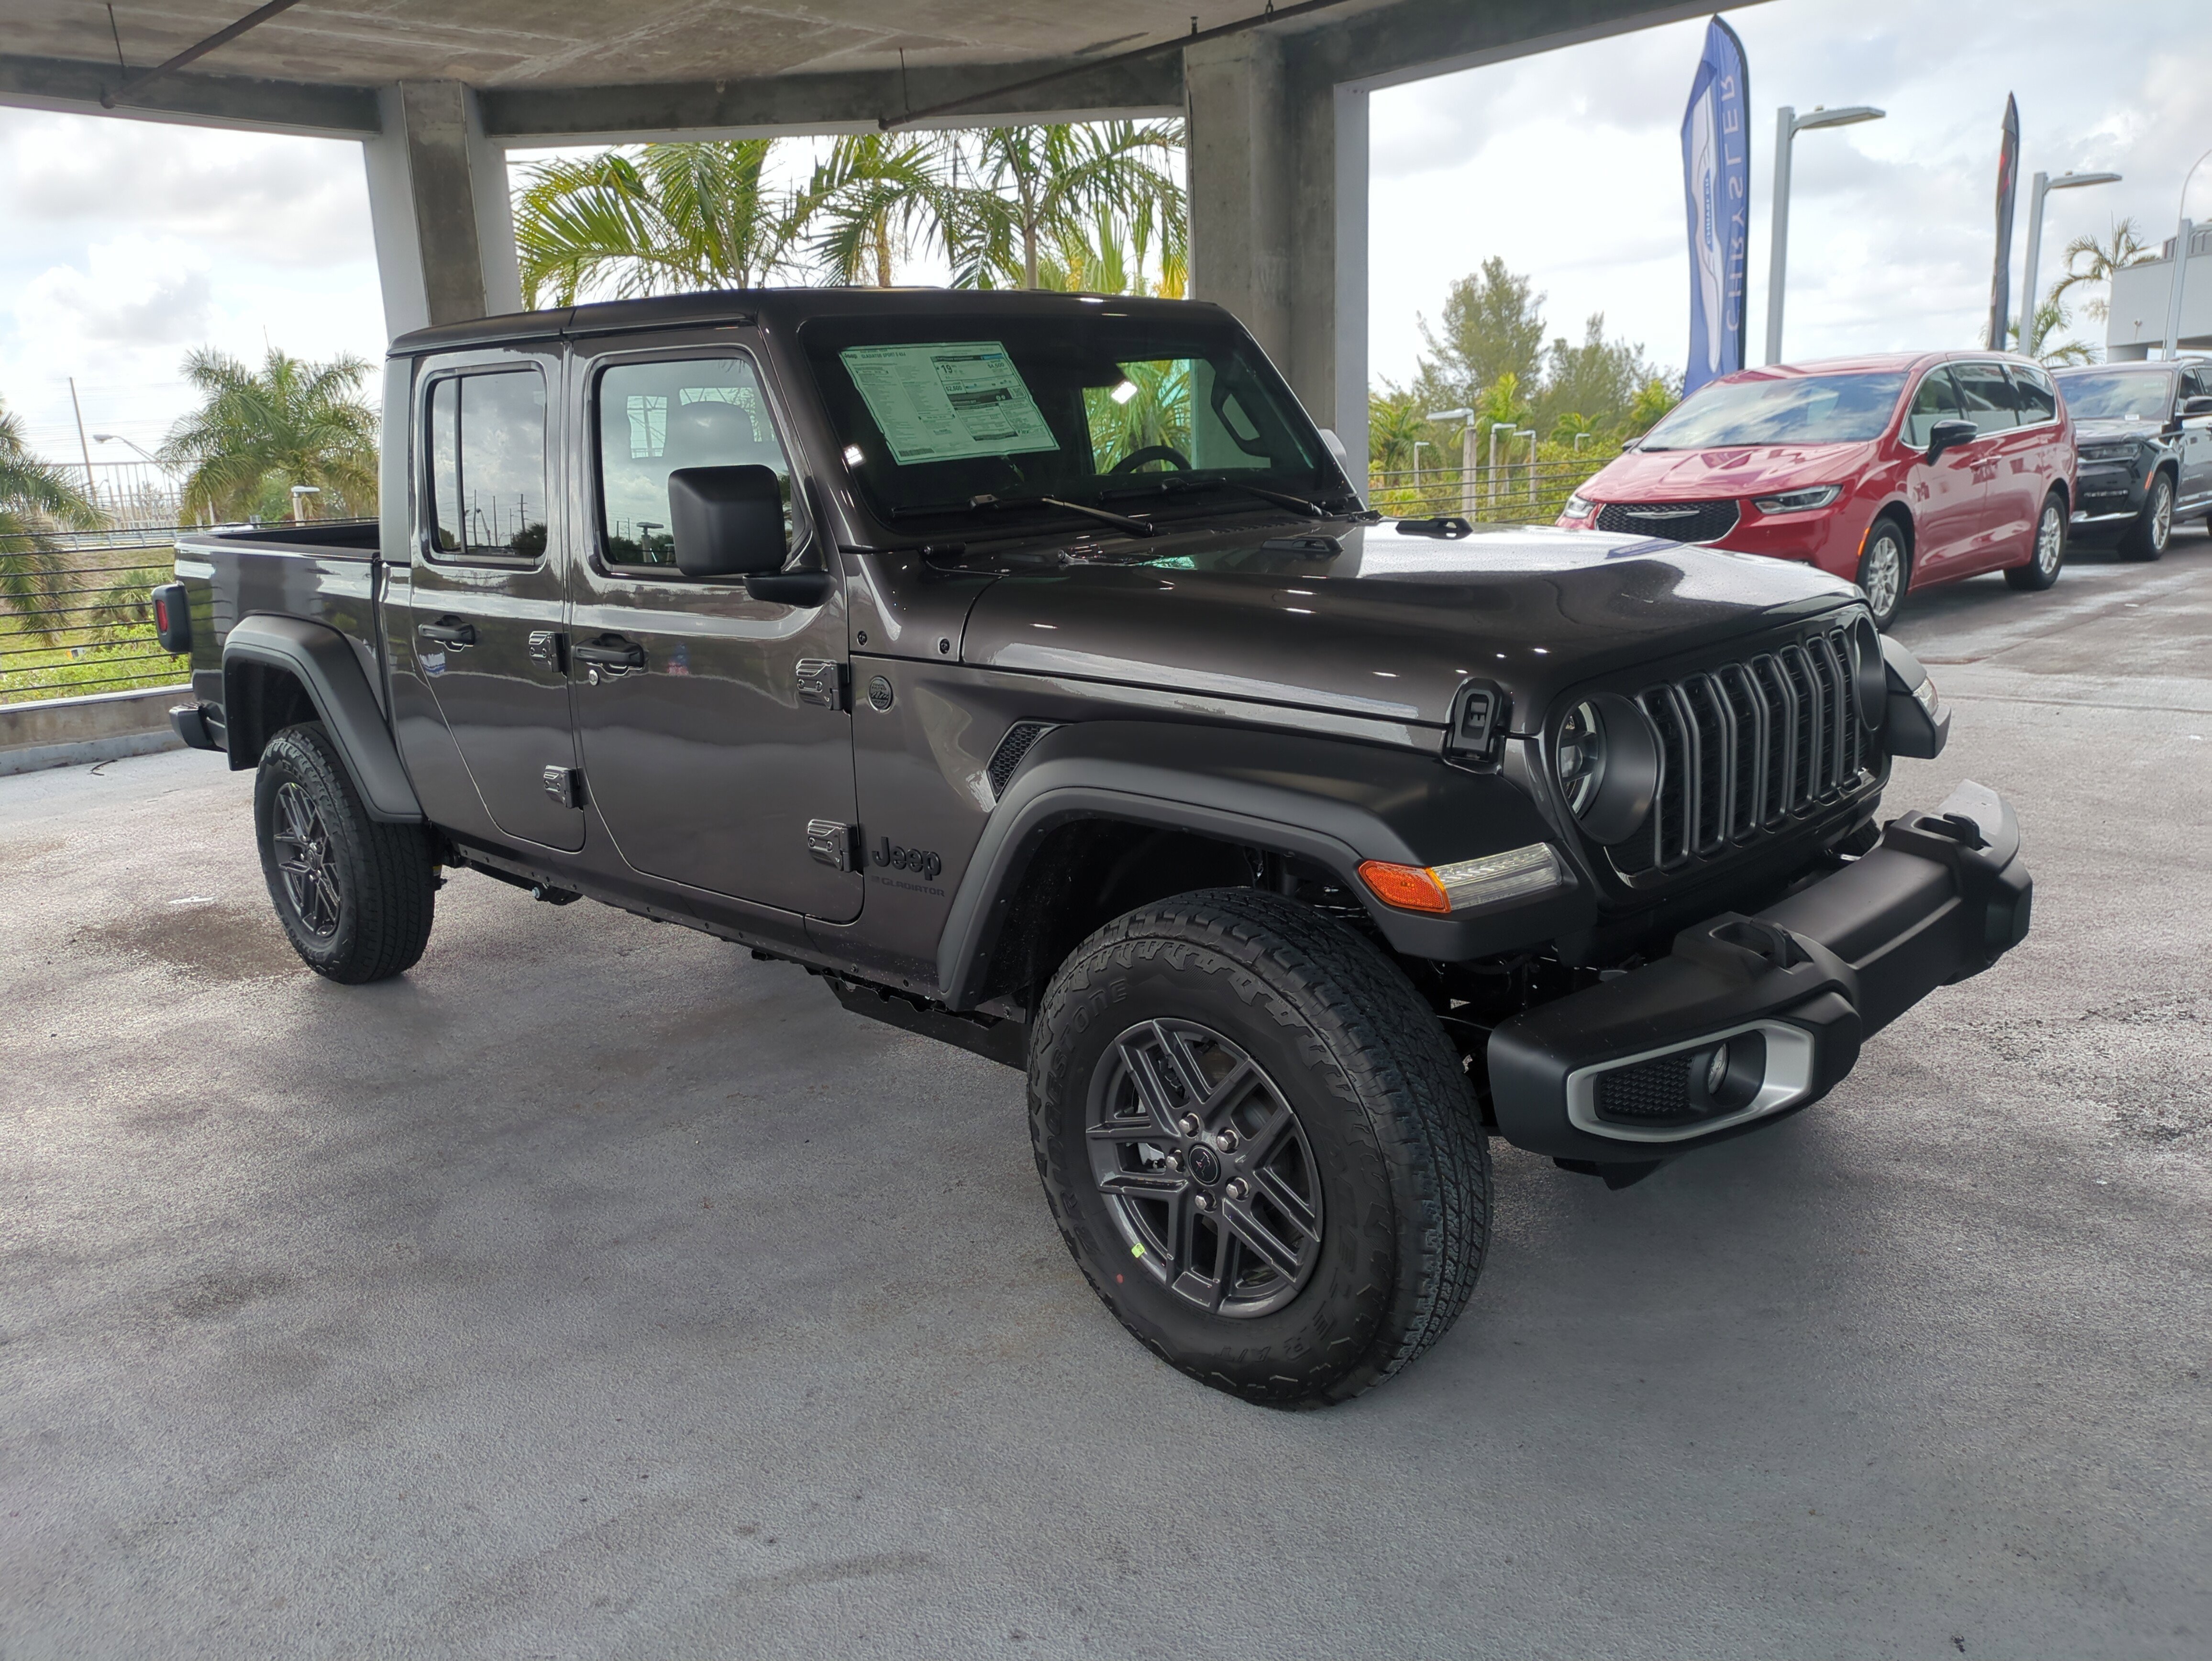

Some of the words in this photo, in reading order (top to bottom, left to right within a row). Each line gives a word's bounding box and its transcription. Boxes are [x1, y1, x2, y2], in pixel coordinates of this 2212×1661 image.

[940, 364, 952, 373] 19
[872, 836, 941, 881] Jeep
[881, 877, 945, 897] GLADIATOR
[1045, 976, 1127, 1254] BRIDGESTONE
